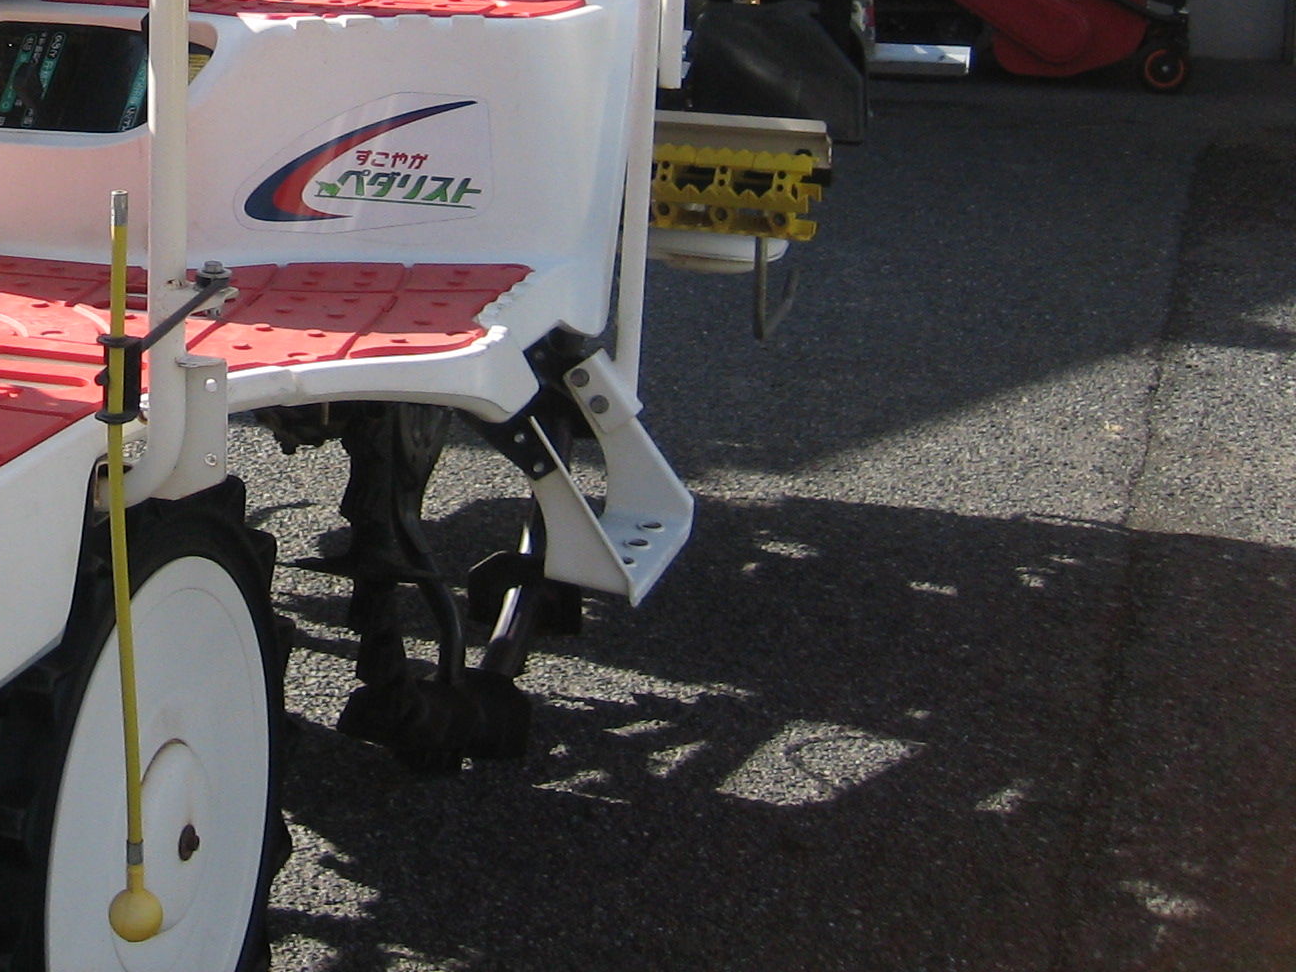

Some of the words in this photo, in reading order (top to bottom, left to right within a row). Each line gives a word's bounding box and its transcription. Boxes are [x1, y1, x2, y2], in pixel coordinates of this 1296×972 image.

[355, 149, 430, 170] すこやか
[337, 170, 482, 204] ペダリスト
